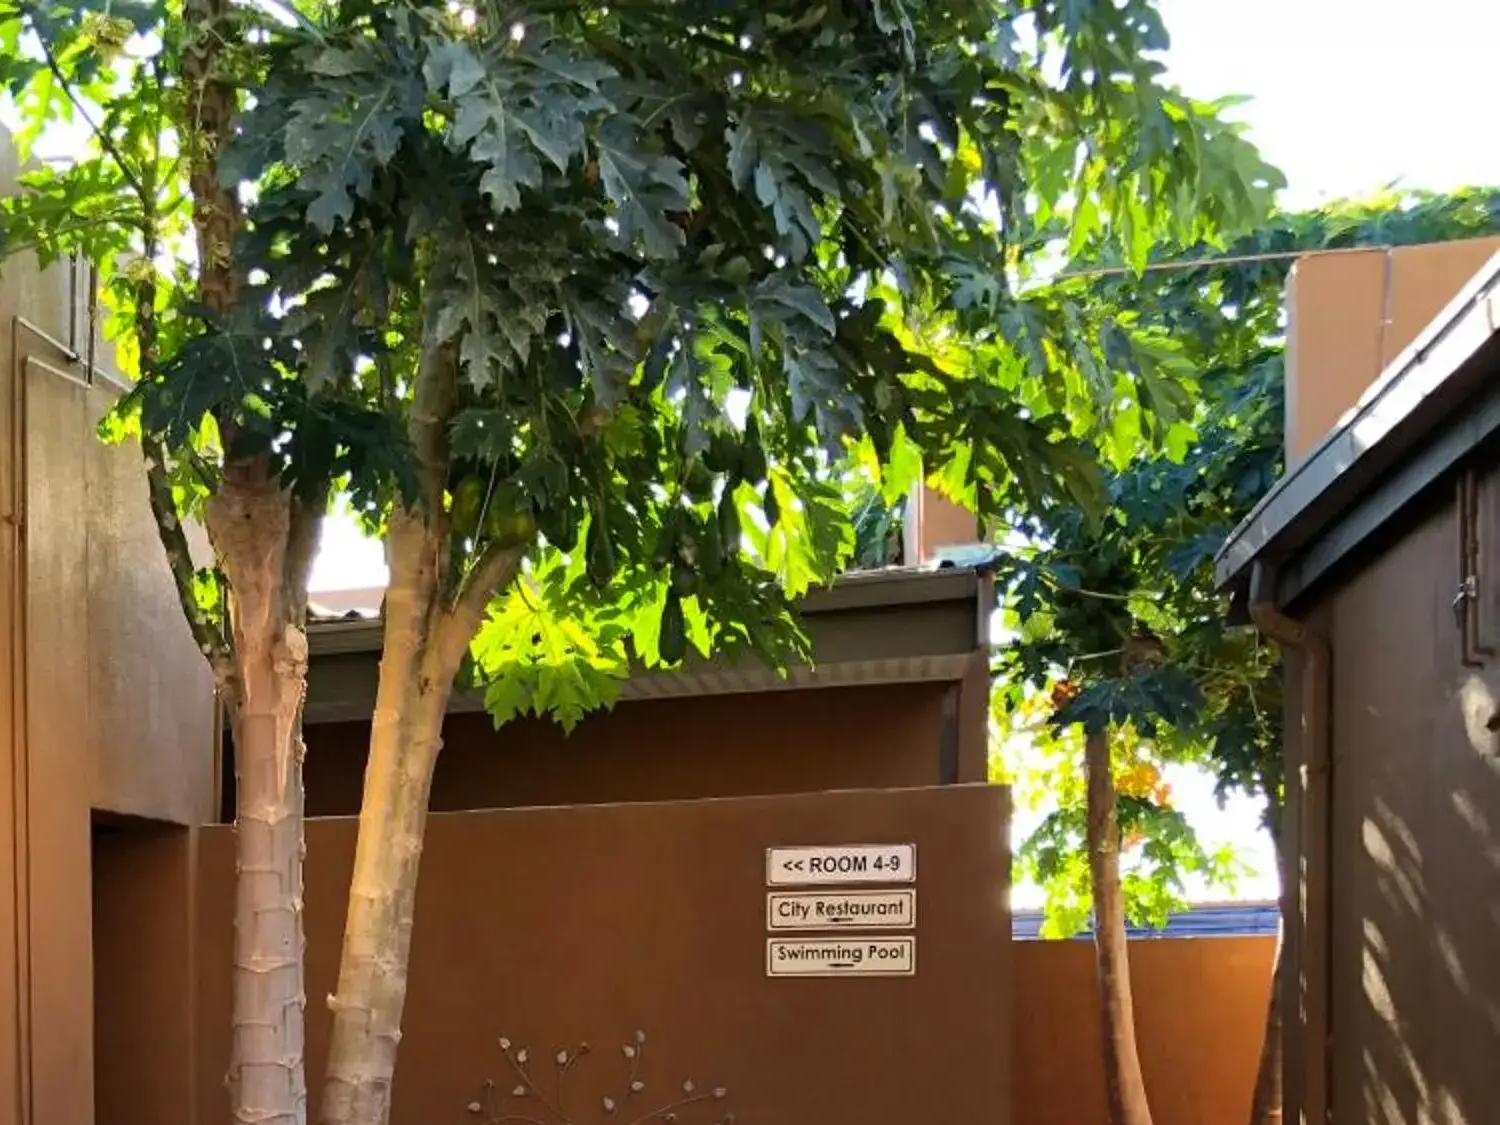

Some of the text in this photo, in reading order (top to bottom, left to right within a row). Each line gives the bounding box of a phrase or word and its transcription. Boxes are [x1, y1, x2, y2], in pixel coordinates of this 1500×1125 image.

[809, 856, 867, 873] ROOM
[873, 855, 901, 871] 4-9
[778, 901, 903, 918] City Restaurant
[777, 945, 905, 962] Swimming Pool
